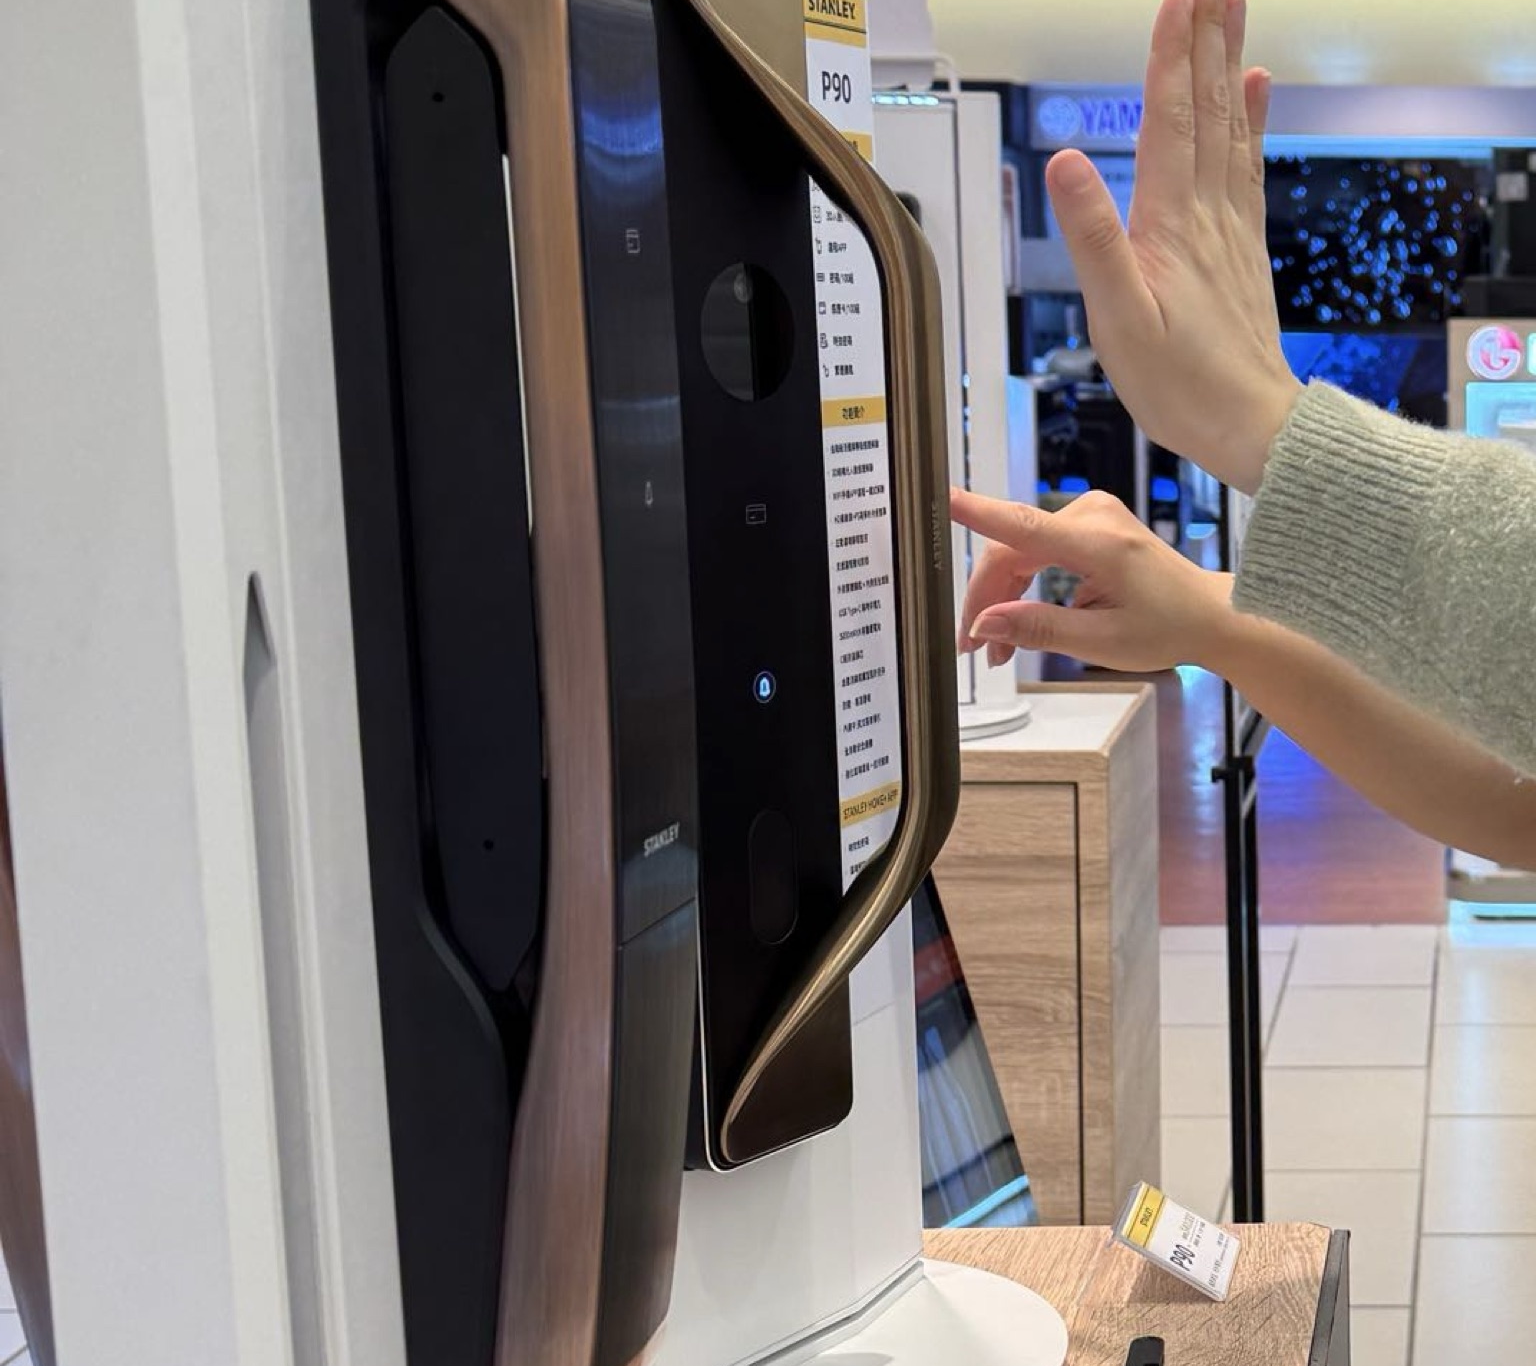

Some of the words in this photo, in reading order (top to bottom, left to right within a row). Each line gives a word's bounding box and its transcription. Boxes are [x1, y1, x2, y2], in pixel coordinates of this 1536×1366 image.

[821, 70, 852, 105] P90
[643, 821, 680, 858] STANLEY
[1169, 1243, 1196, 1271] P90
